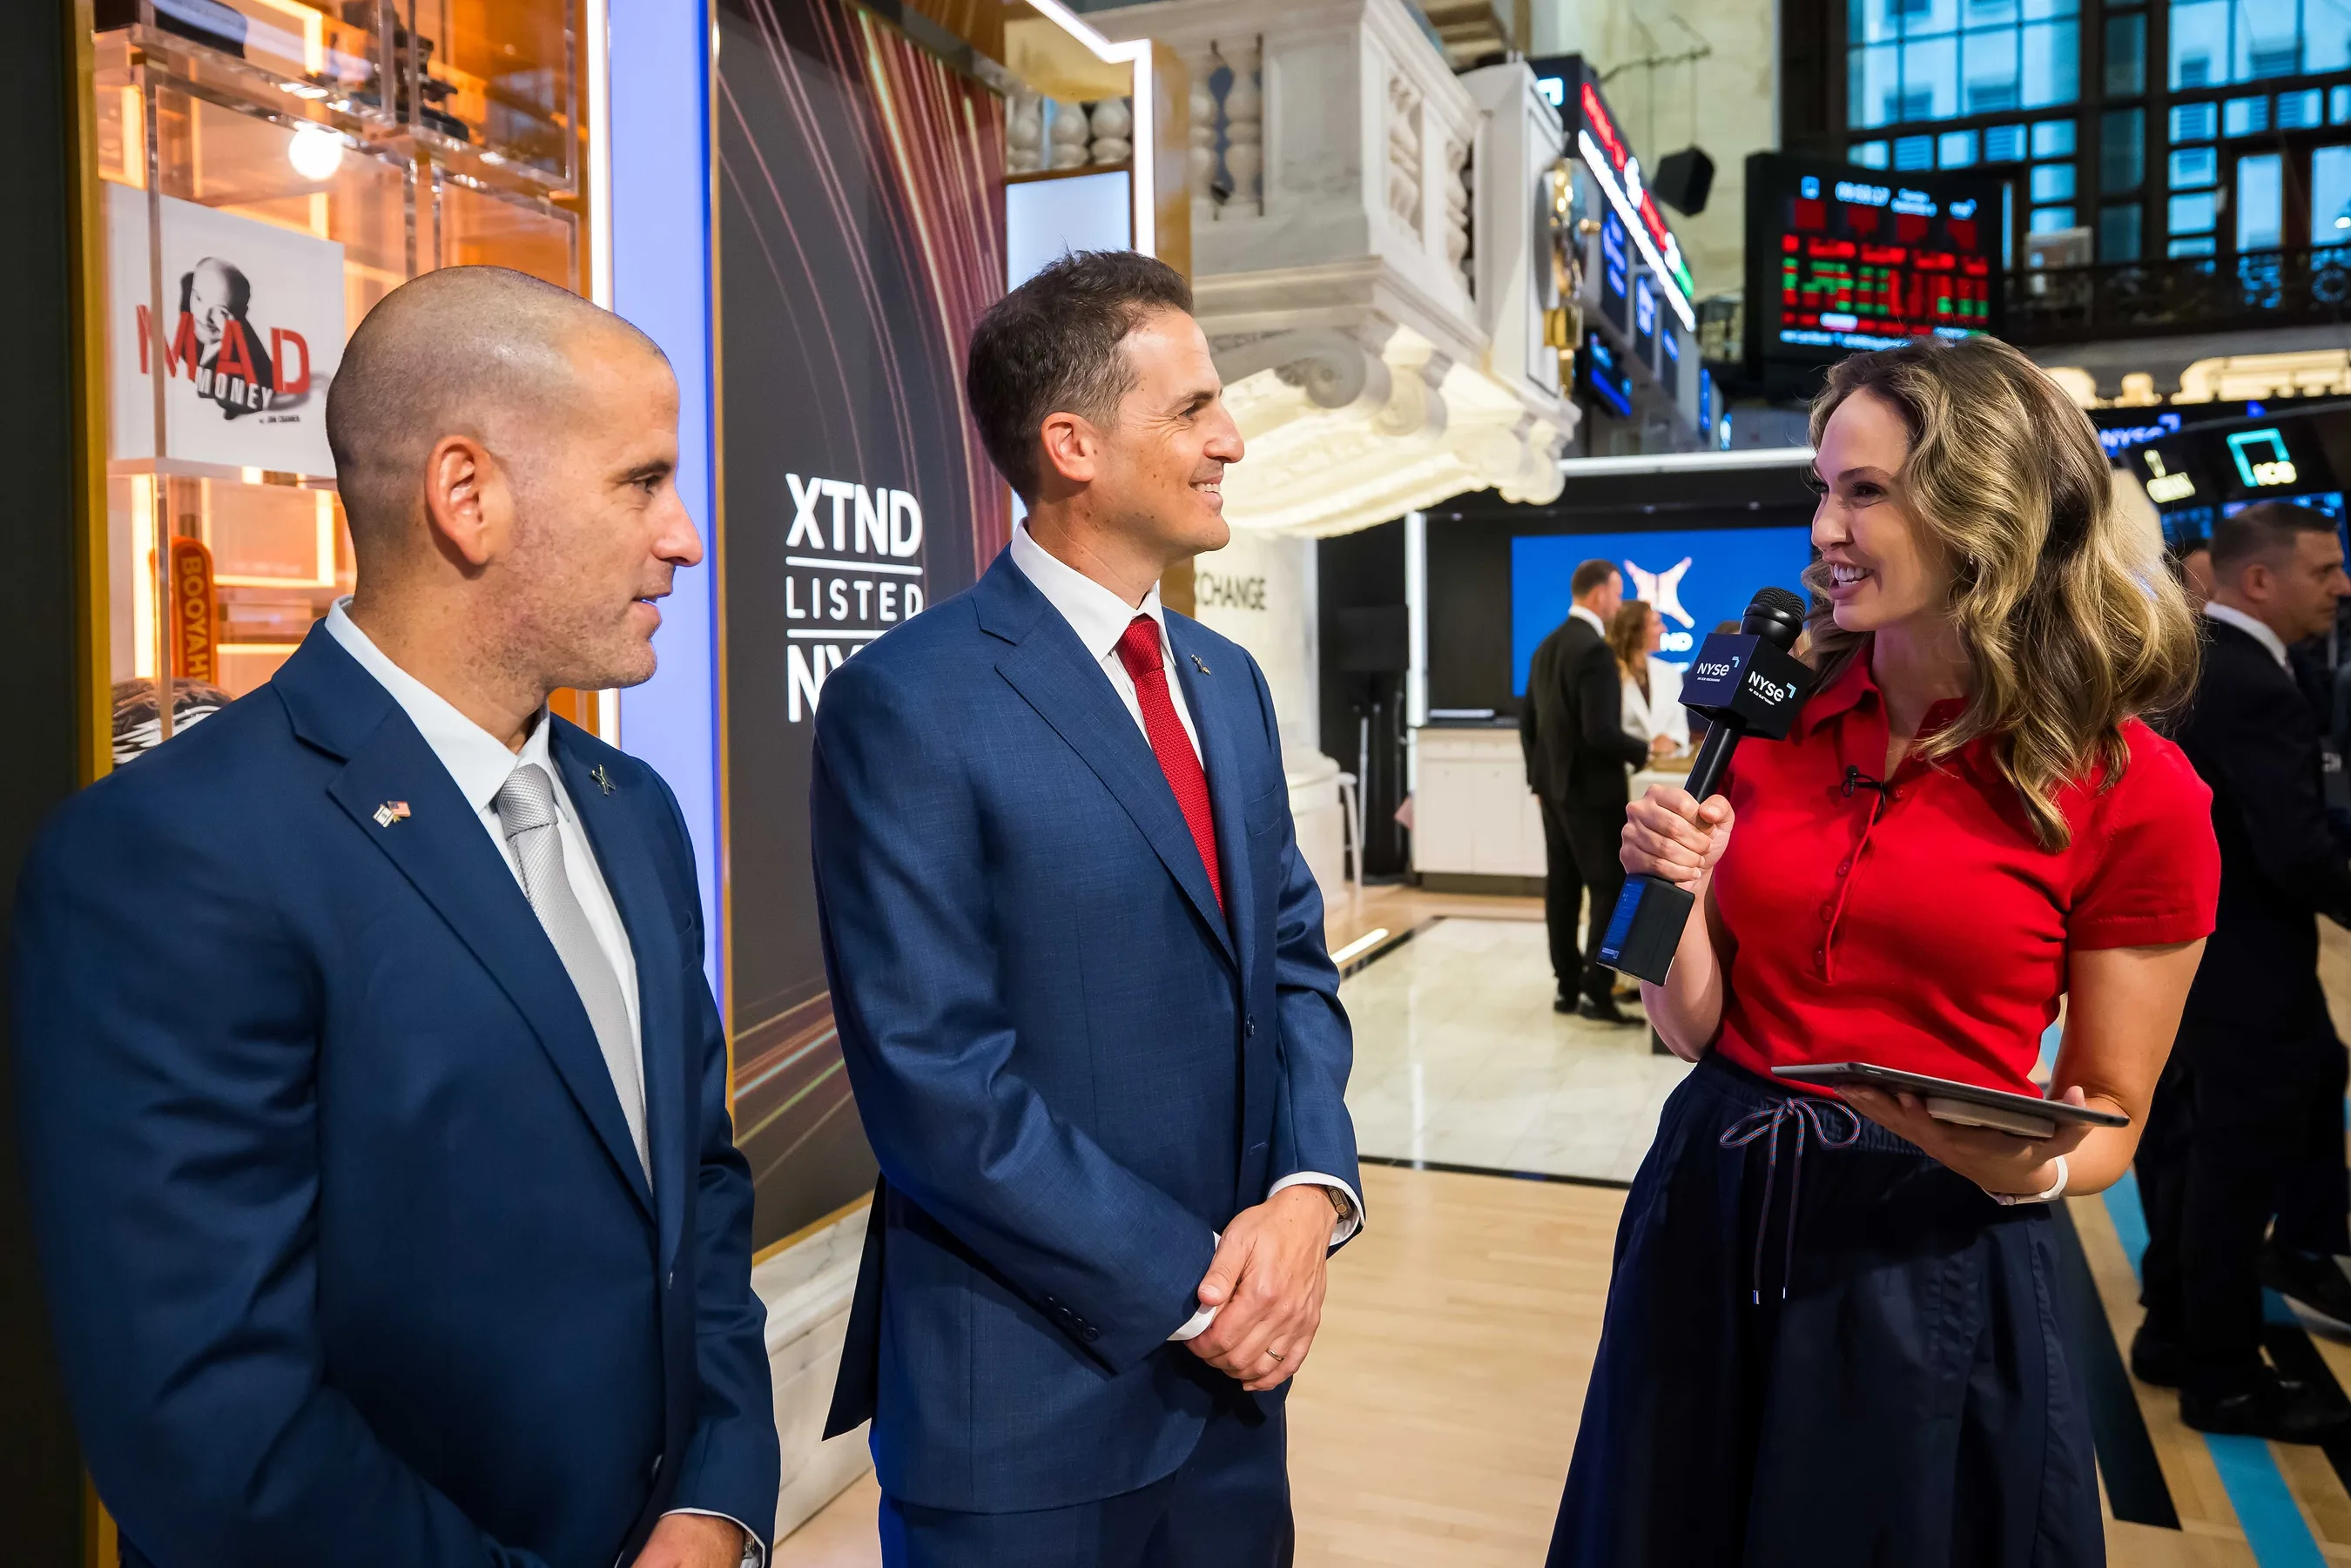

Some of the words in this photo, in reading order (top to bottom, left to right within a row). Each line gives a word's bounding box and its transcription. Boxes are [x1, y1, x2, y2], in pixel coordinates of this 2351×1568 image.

[136, 305, 311, 394] MAD
[195, 366, 273, 412] MONEY
[785, 473, 924, 558] XTND
[785, 575, 925, 622] LISTED
[1196, 571, 1266, 611] CHANGE
